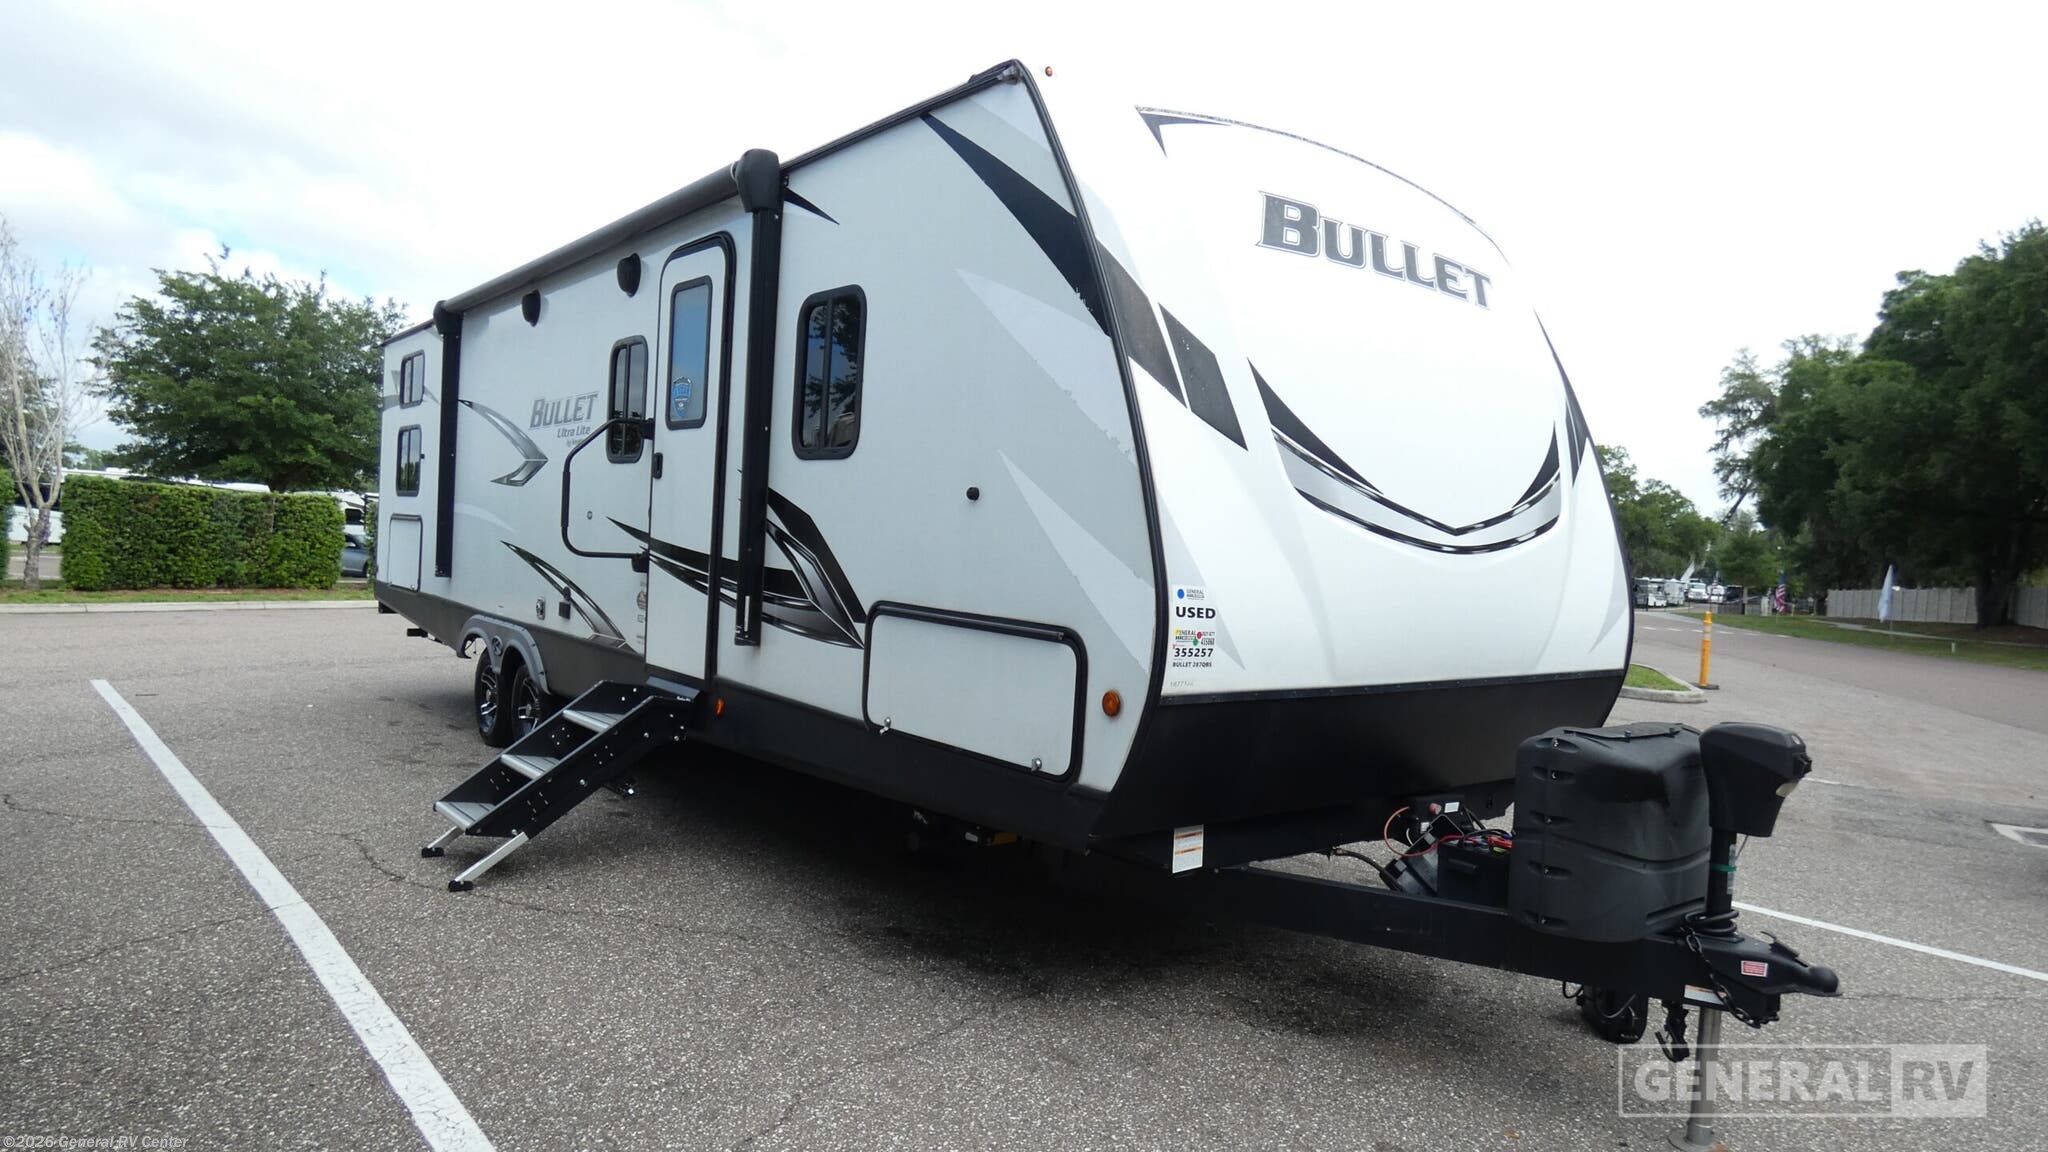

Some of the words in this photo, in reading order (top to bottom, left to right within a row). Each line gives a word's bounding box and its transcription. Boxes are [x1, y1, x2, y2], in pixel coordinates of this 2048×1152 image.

[1256, 190, 1493, 311] BULLET
[529, 391, 600, 430] BULLET
[557, 427, 575, 438] Ultra
[576, 425, 591, 436] Lite
[1175, 605, 1216, 619] USED
[1173, 647, 1214, 658] 355257
